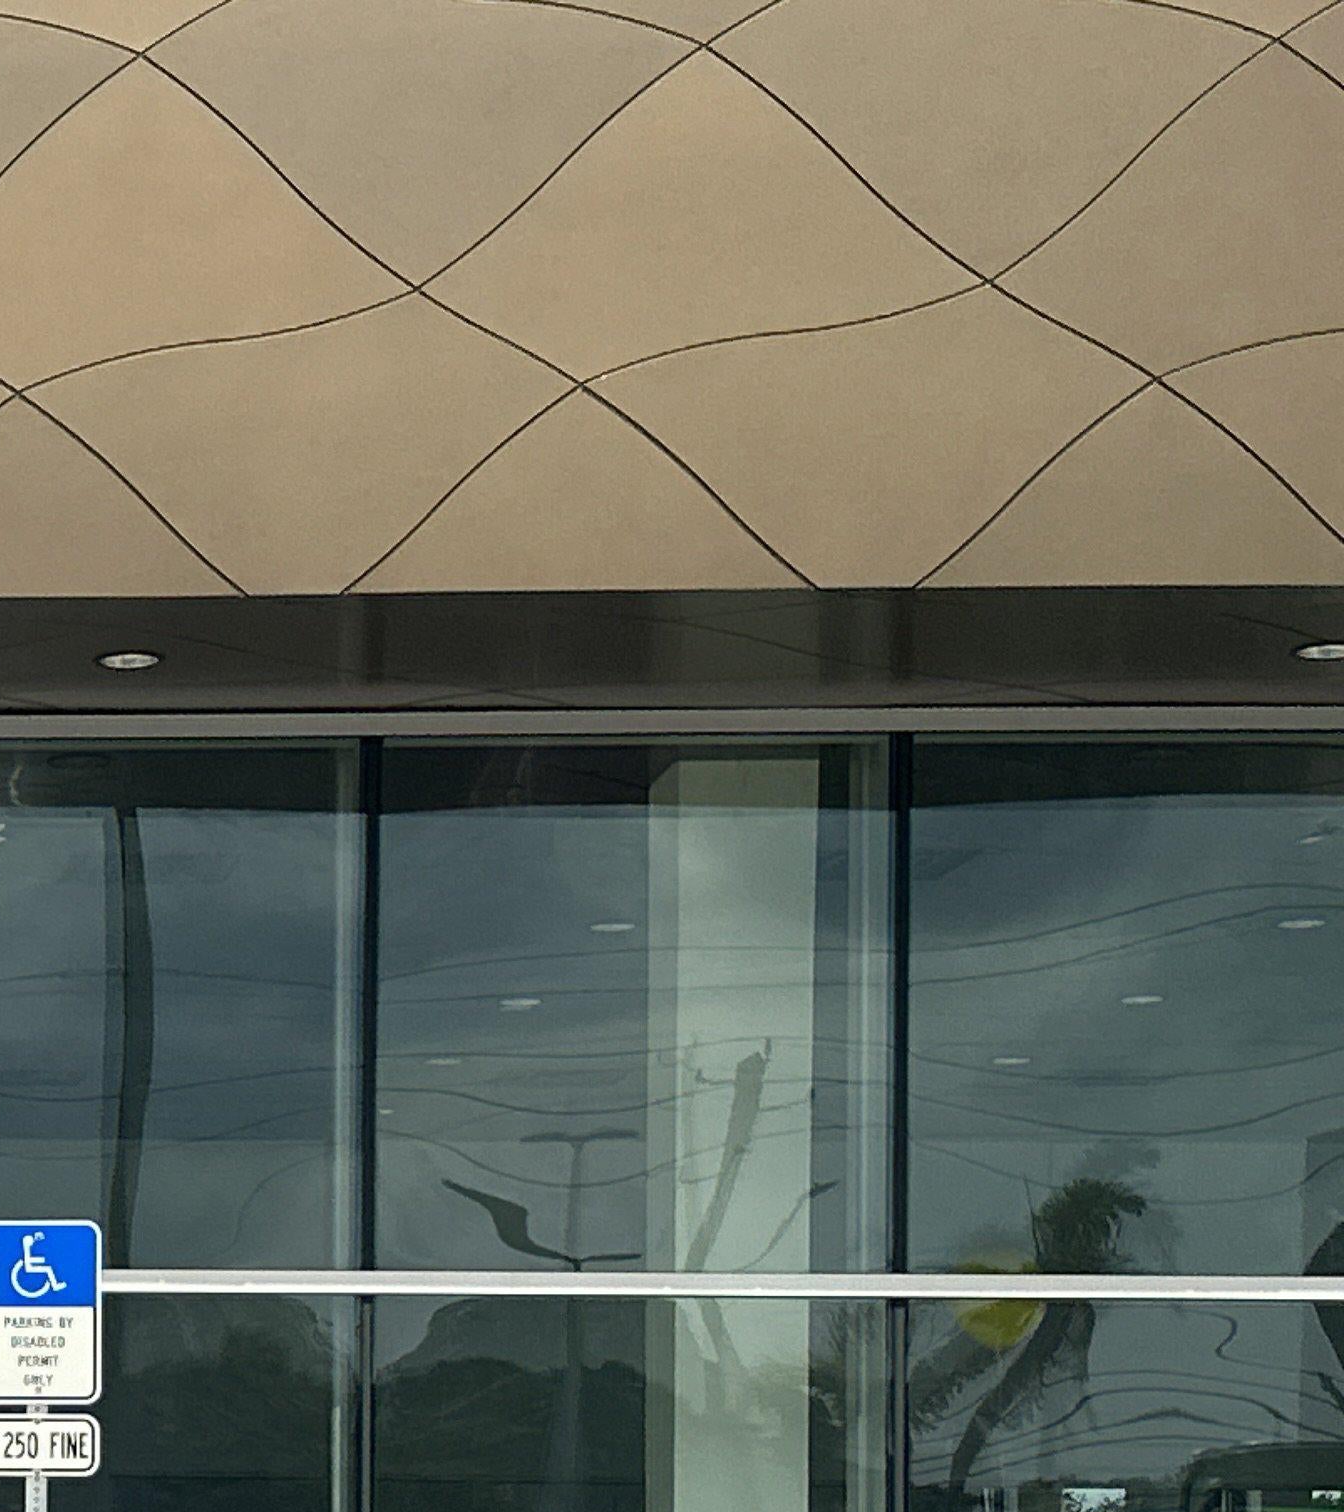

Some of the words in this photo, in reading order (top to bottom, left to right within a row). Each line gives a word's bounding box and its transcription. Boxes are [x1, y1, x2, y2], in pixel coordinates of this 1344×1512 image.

[4, 1316, 53, 1329] PARKING
[59, 1316, 73, 1329] BY
[11, 1335, 66, 1348] DISABLED
[18, 1354, 59, 1367] PERMIT
[50, 1432, 89, 1460] FINE
